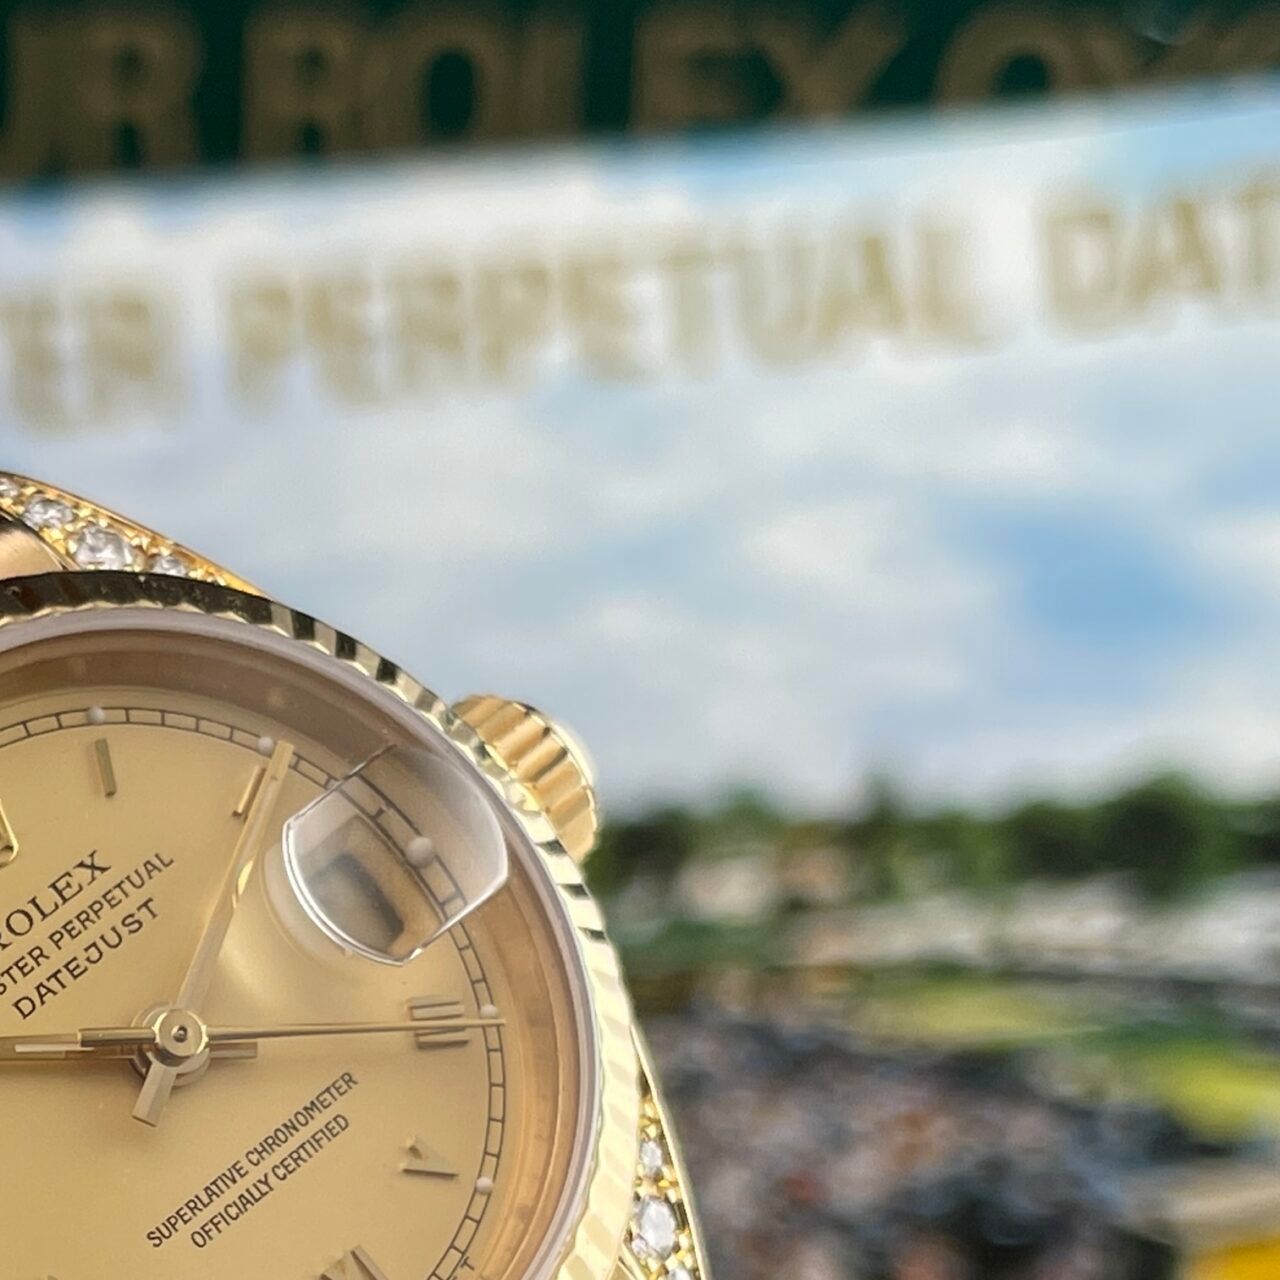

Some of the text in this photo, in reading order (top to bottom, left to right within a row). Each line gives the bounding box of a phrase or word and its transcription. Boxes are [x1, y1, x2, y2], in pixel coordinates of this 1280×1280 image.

[242, 8, 910, 170] ROLEX
[220, 212, 992, 412] PERPETUAL
[12, 897, 159, 1020] DATEJUST
[48, 853, 174, 950] PERPETUAL
[146, 1072, 358, 1248] SUPERLATIVE CHRONOMETER
[190, 1114, 350, 1249] OFFICIALLY CERTIFIED
